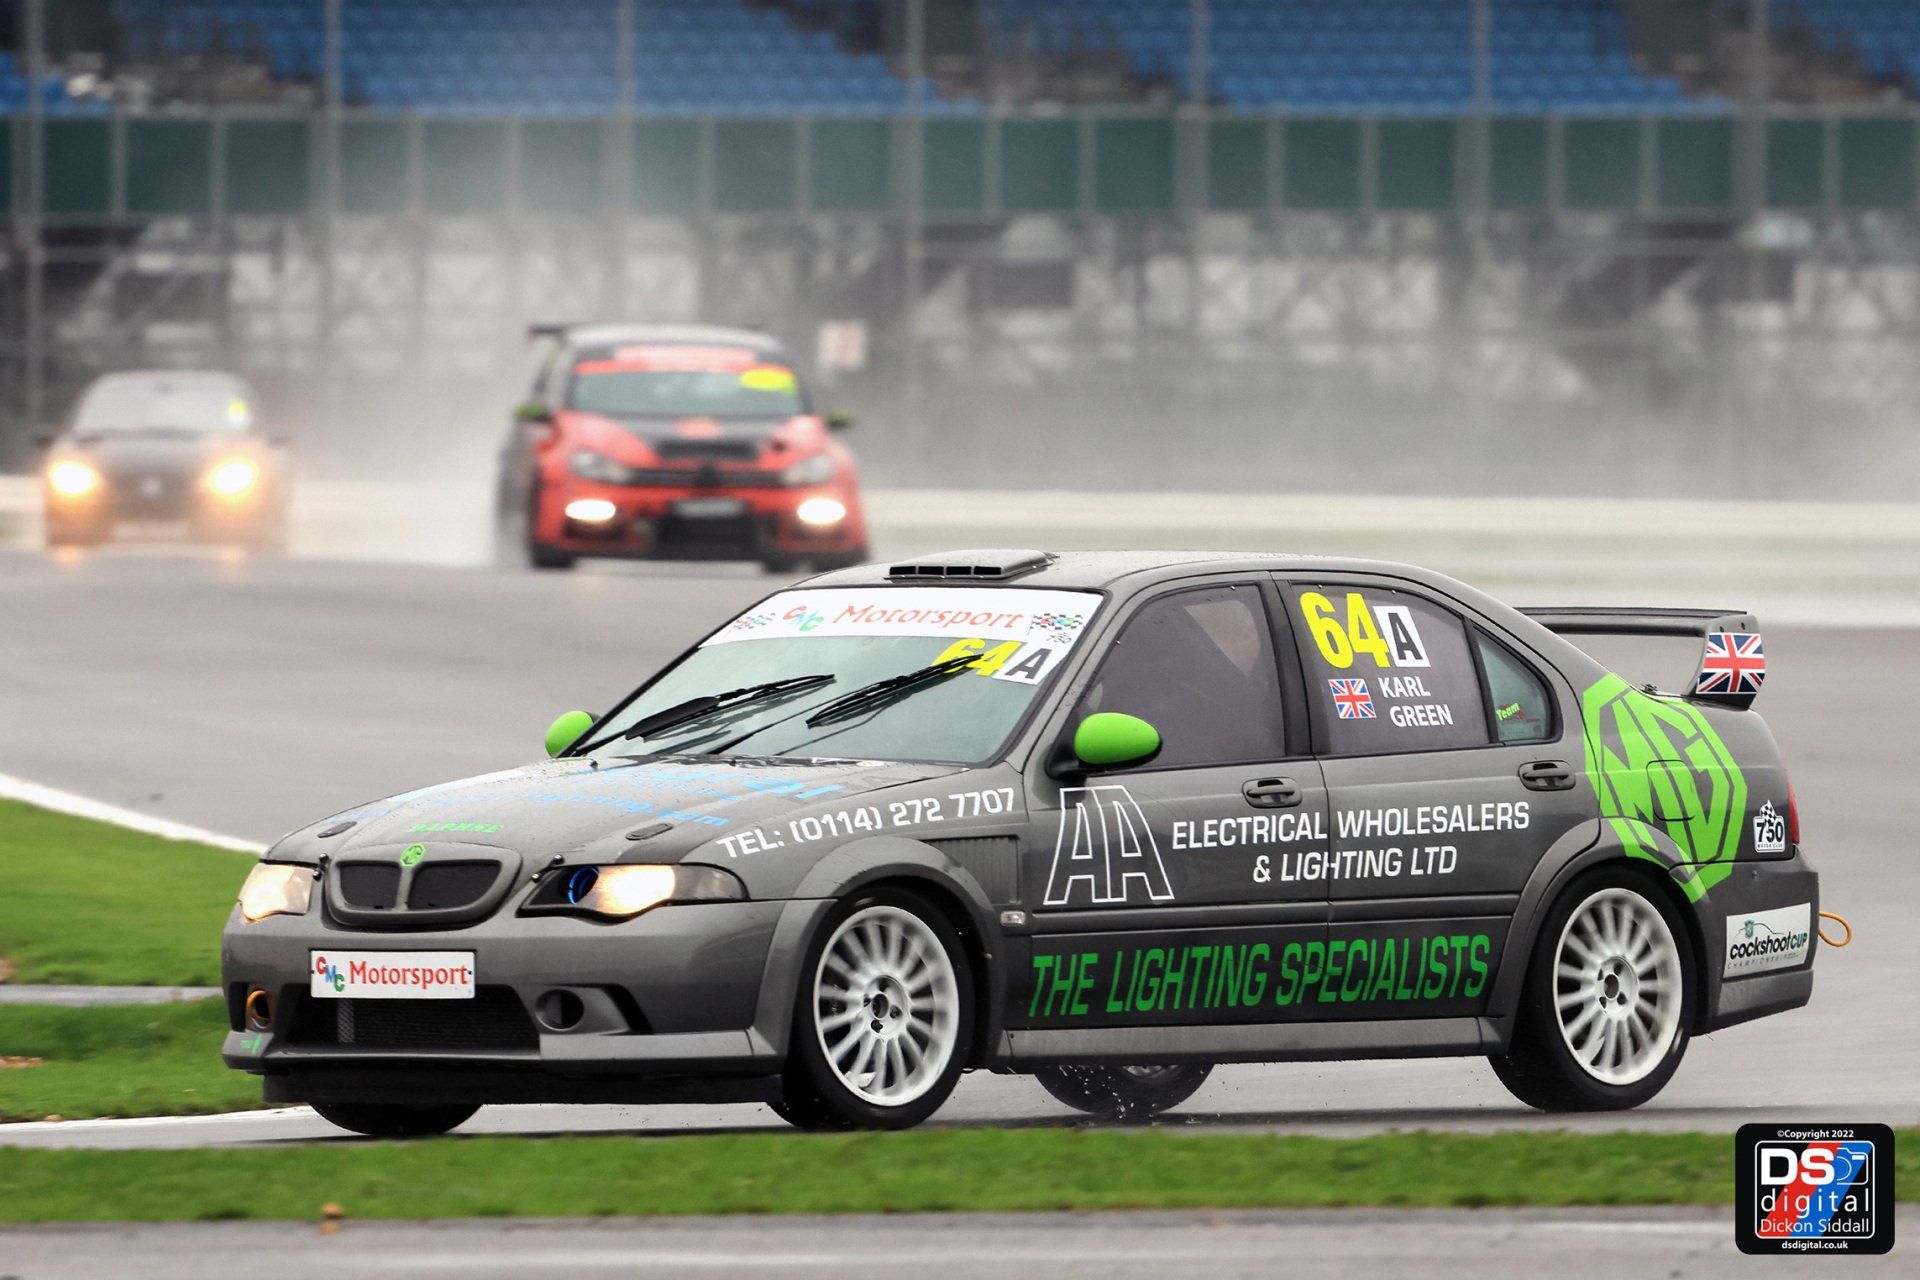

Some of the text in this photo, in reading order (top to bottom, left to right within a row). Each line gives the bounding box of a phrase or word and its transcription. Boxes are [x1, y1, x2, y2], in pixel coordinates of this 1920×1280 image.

[833, 604, 1025, 629] Motorsport
[1378, 676, 1431, 698] KARL
[1389, 703, 1454, 728] GREEN
[1495, 703, 1520, 721] Team
[715, 787, 1015, 858] TEL: (0114) 272 7707
[1172, 801, 1530, 850] ELECTRICAL WHOLESALERS
[1756, 821, 1784, 843] 750
[1252, 845, 1458, 883] & LIGHTING LTD
[316, 956, 468, 992] CMC Motorsport
[1029, 934, 1490, 1017] THE LIGHTING SPECIALISTS
